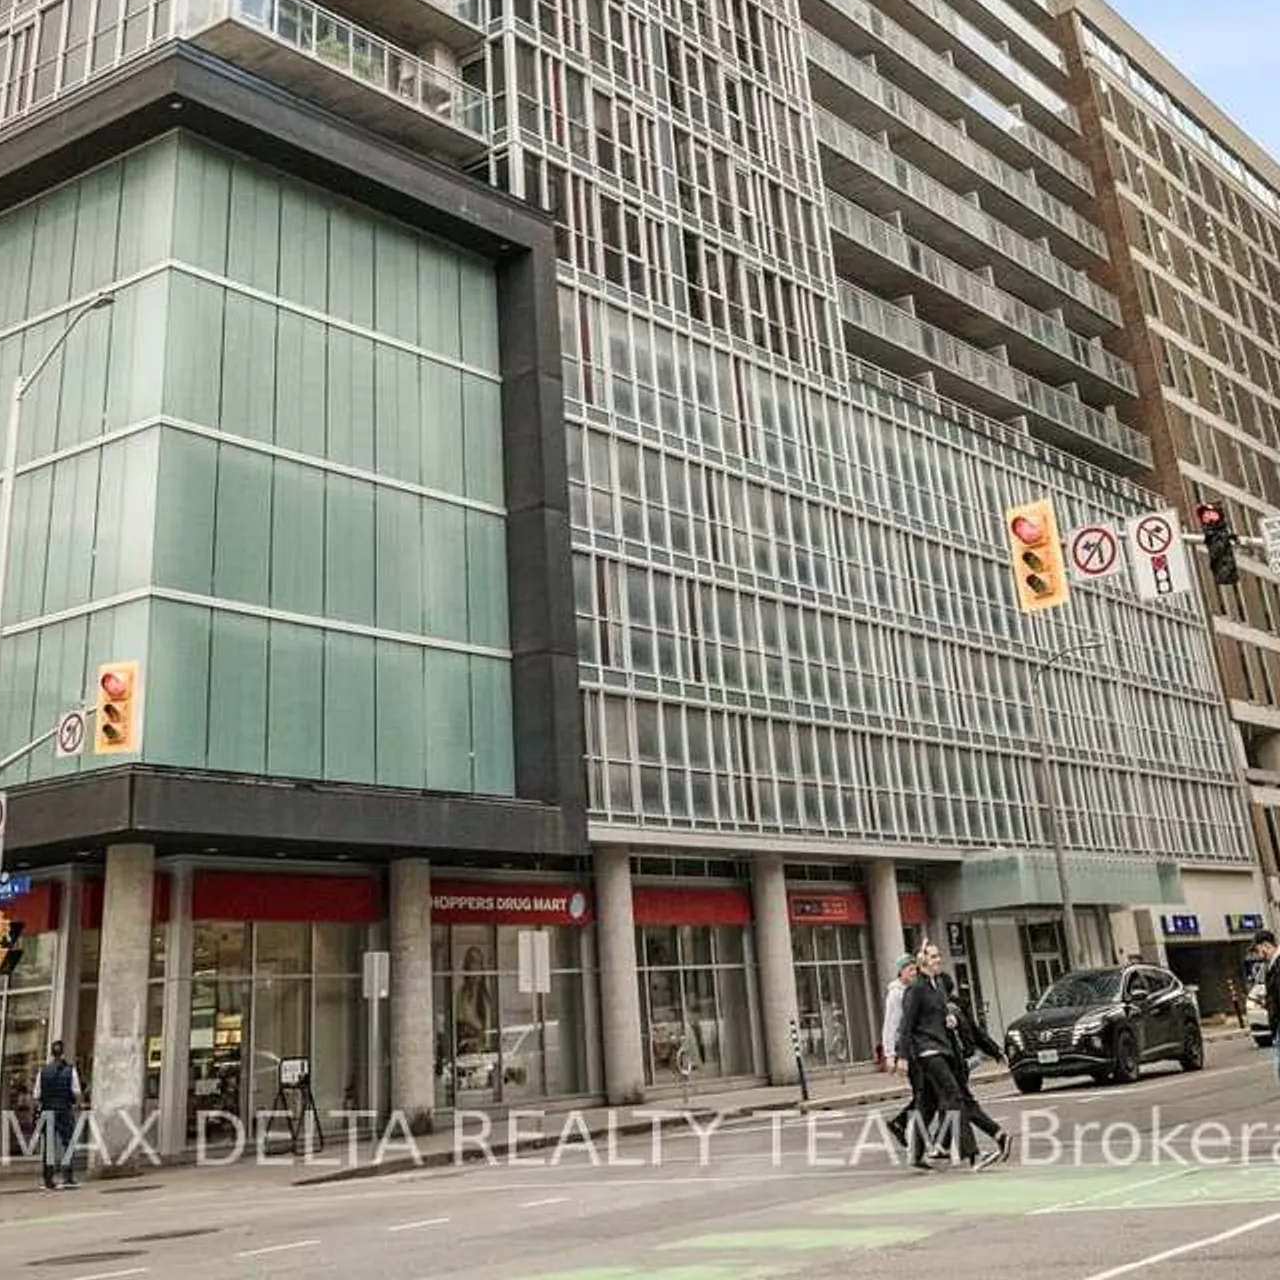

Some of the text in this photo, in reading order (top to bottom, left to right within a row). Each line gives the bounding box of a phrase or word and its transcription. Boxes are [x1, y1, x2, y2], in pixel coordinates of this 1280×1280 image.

[431, 895, 568, 912] HOPPERS DRUG MART
